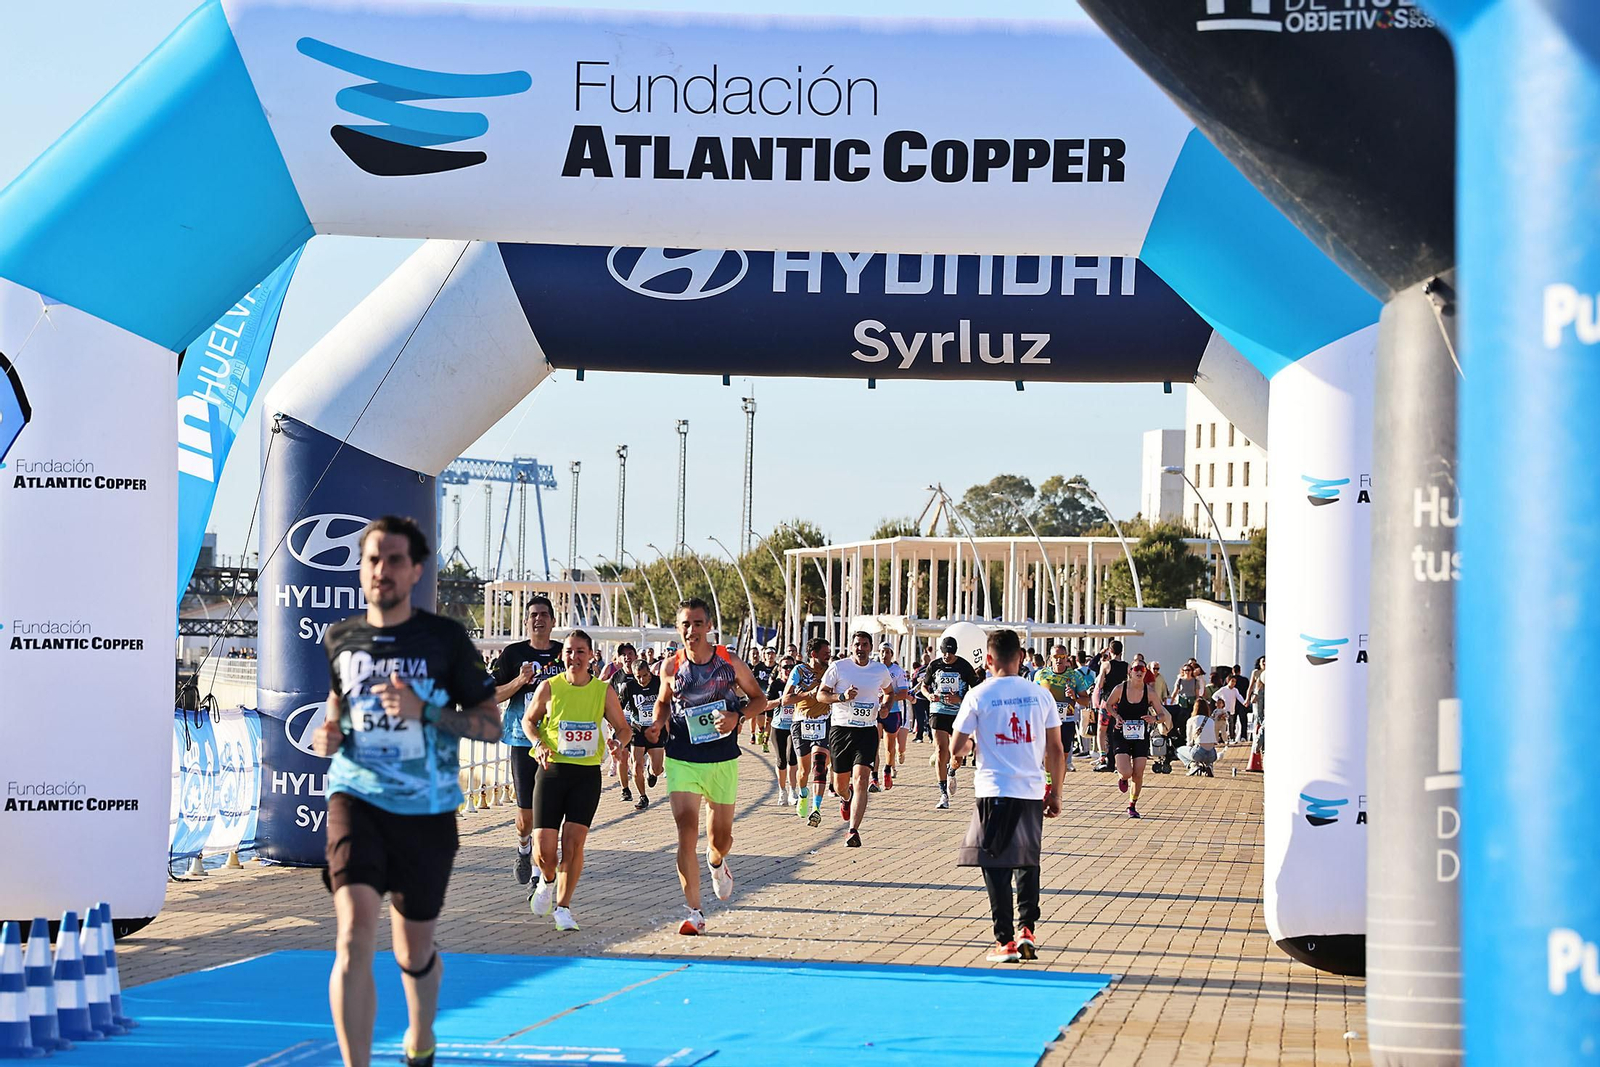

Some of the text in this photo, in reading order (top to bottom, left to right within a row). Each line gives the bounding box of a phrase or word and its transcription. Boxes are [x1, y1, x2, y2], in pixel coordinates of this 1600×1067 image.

[575, 60, 877, 116] Fundación
[561, 124, 1127, 184] ATLANTIC COPPER
[772, 250, 1137, 297] HYUNDAI
[851, 318, 1052, 370] Syrluz
[16, 459, 94, 473] Fundación
[13, 475, 147, 491] ATLANTIC COPPER
[1357, 490, 1371, 503] A
[1413, 486, 1462, 528] Hu
[13, 619, 91, 634] Fundación
[10, 636, 144, 651] ATLANTIC COPPER
[1355, 650, 1368, 663] A
[371, 658, 428, 679] HUELVA
[853, 708, 871, 717] 393
[363, 714, 408, 733] 542
[805, 723, 821, 731] 911
[565, 731, 593, 742] 938
[7, 780, 87, 796] Fundación
[4, 797, 139, 812] ATLANTIC COPPER
[1356, 811, 1368, 825] A
